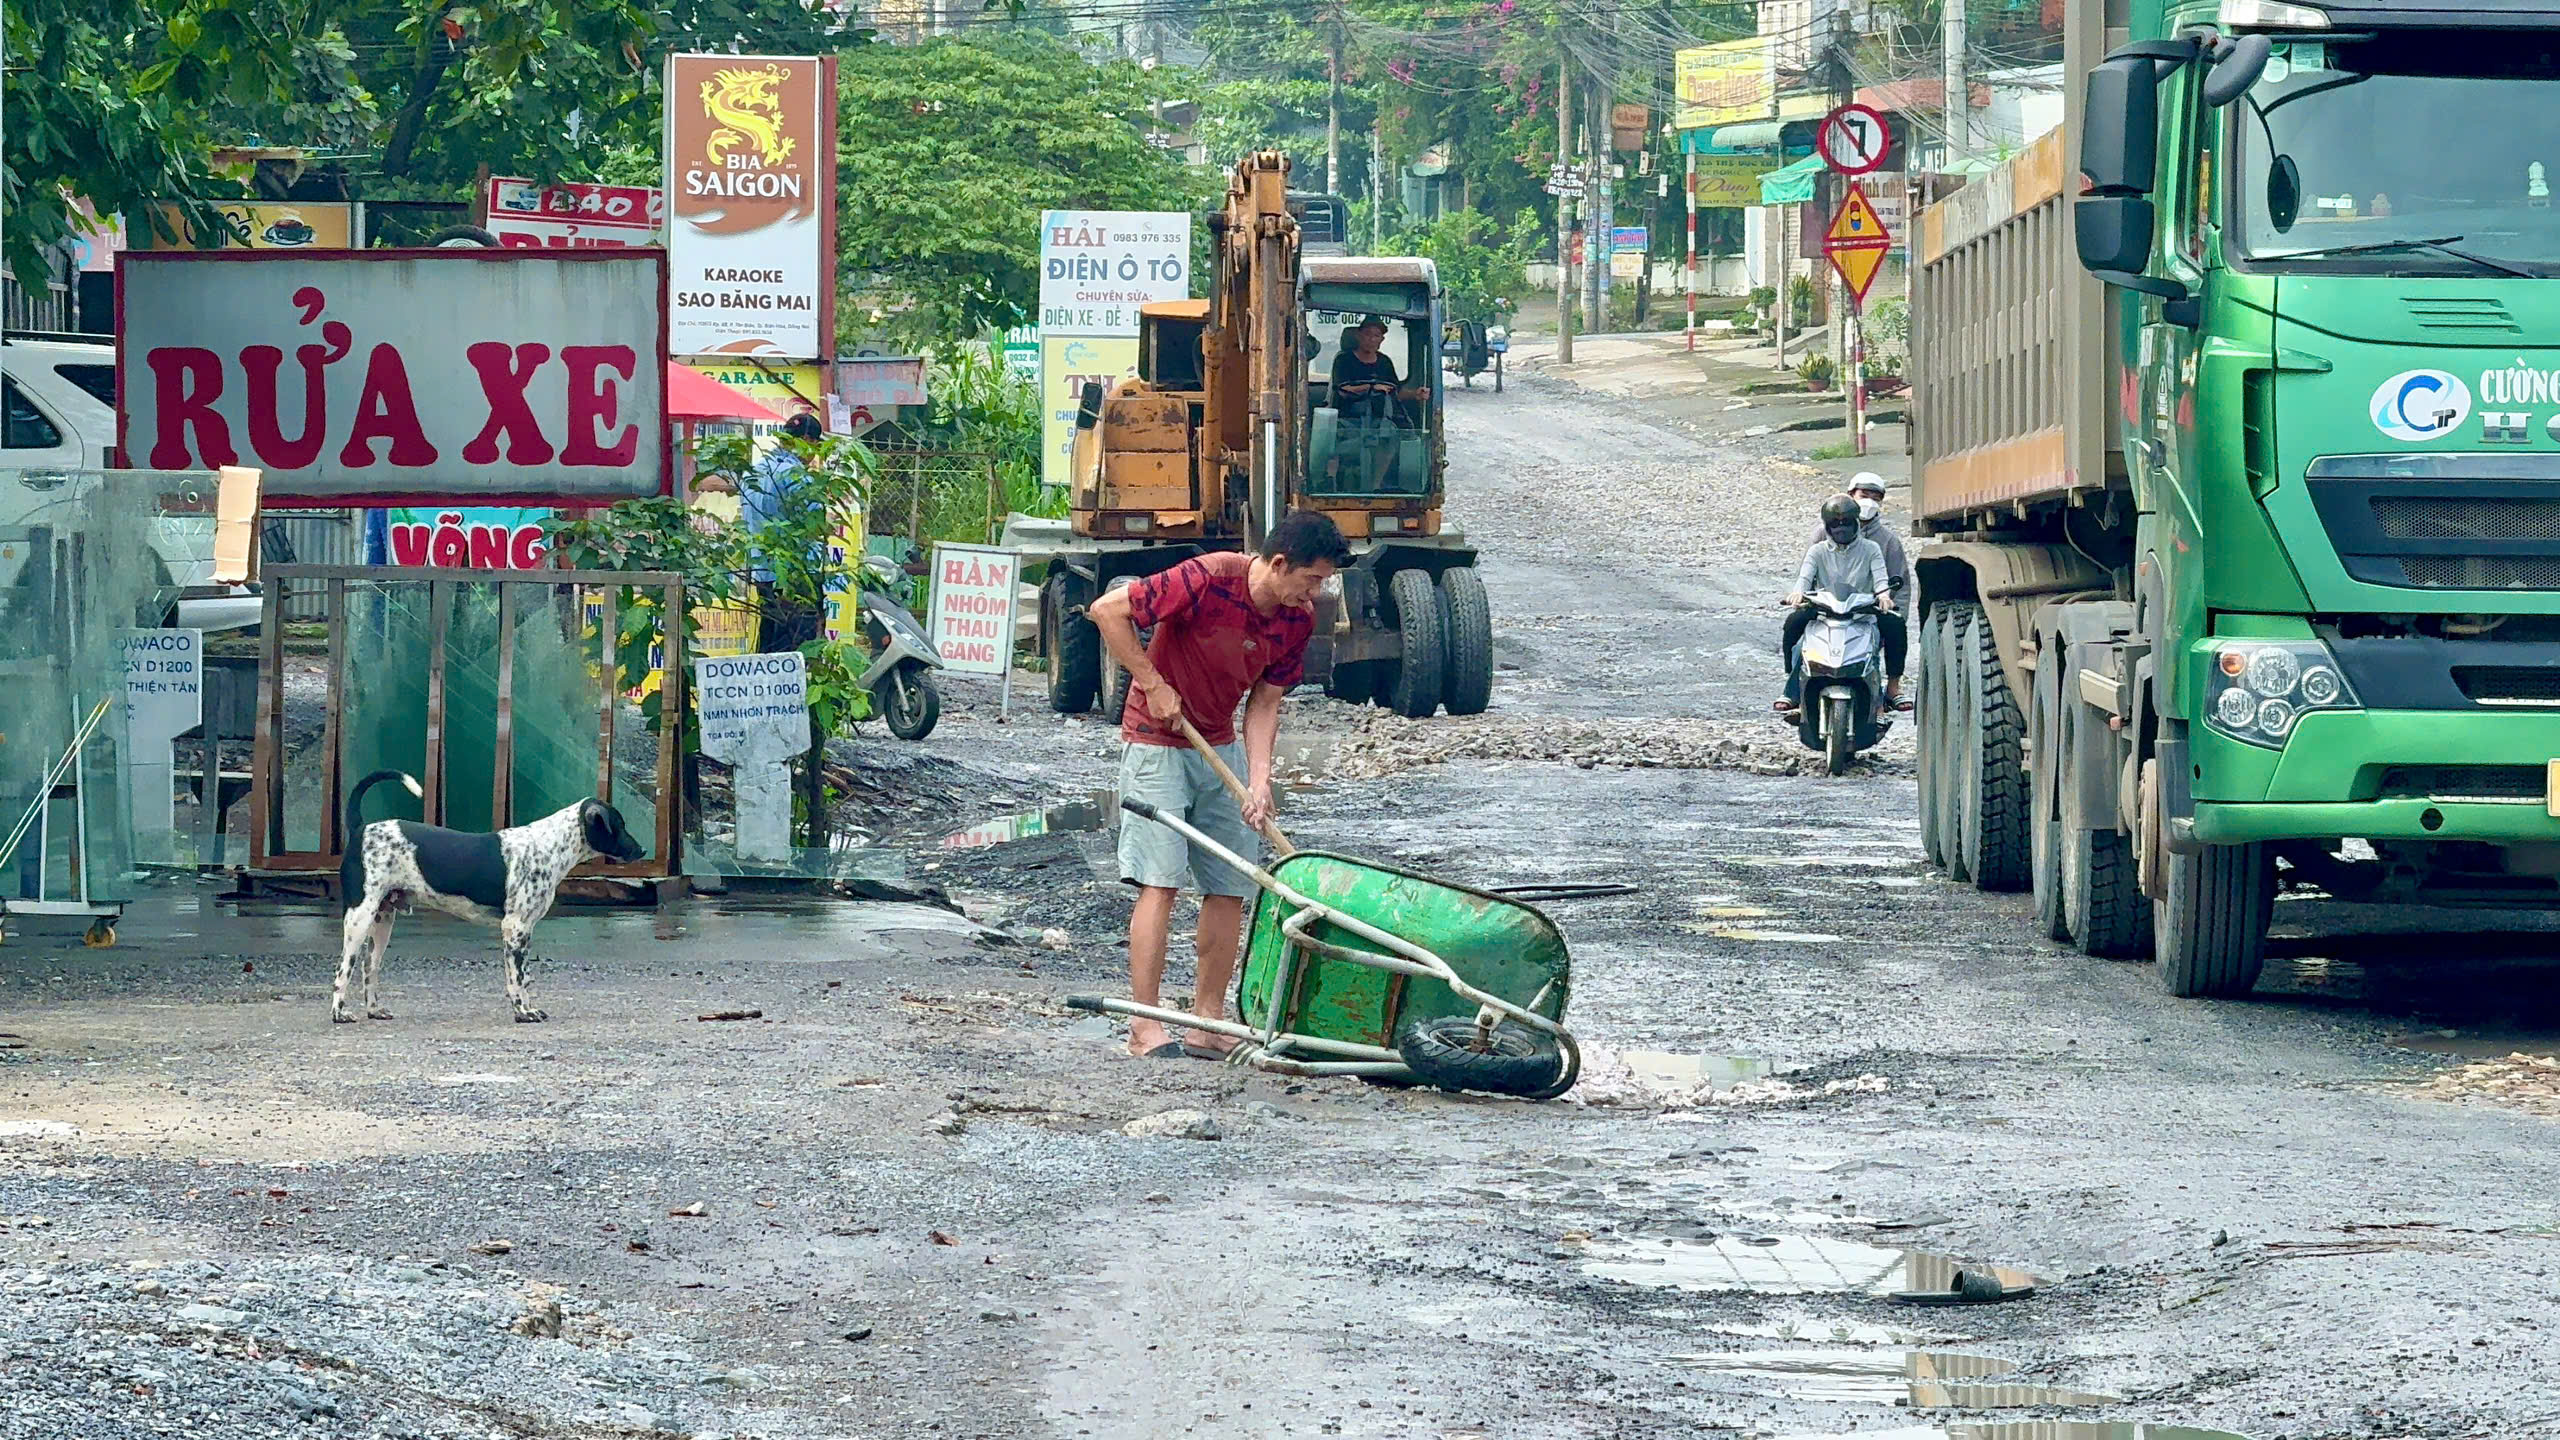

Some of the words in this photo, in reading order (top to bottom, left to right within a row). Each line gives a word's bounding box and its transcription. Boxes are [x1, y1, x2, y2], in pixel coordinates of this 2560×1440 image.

[727, 154, 762, 170] BIA
[686, 169, 801, 198] SAIGON
[1051, 219, 1107, 247] HẢI
[1113, 233, 1138, 243] 0983
[1141, 234, 1159, 243] 976
[1162, 234, 1181, 243] 335
[704, 268, 784, 283] KARAOKE
[1047, 252, 1108, 287] ĐIỆN
[1118, 252, 1139, 281] Ô
[1148, 253, 1182, 281] TÔ
[677, 292, 715, 307] SAO
[720, 289, 772, 309] BĂNG
[776, 295, 811, 310] MAI
[1076, 290, 1123, 302] CHUYÊN
[1045, 305, 1073, 329] ĐIỆN
[1078, 309, 1093, 326] XE
[146, 286, 439, 470] RỬA
[462, 341, 639, 467] XE
[392, 511, 546, 569] VÕNG
[944, 556, 1008, 588] HÀN
[944, 592, 1007, 616] NHÔM
[944, 617, 998, 639] THAU
[941, 641, 995, 663] GANG
[147, 660, 192, 673] D1200
[706, 659, 796, 678] DOWACO
[128, 680, 167, 694] THIỆN
[171, 681, 197, 693] TÂN
[704, 686, 748, 698] TCCN
[754, 684, 800, 696] D1000
[704, 709, 728, 720] NMN
